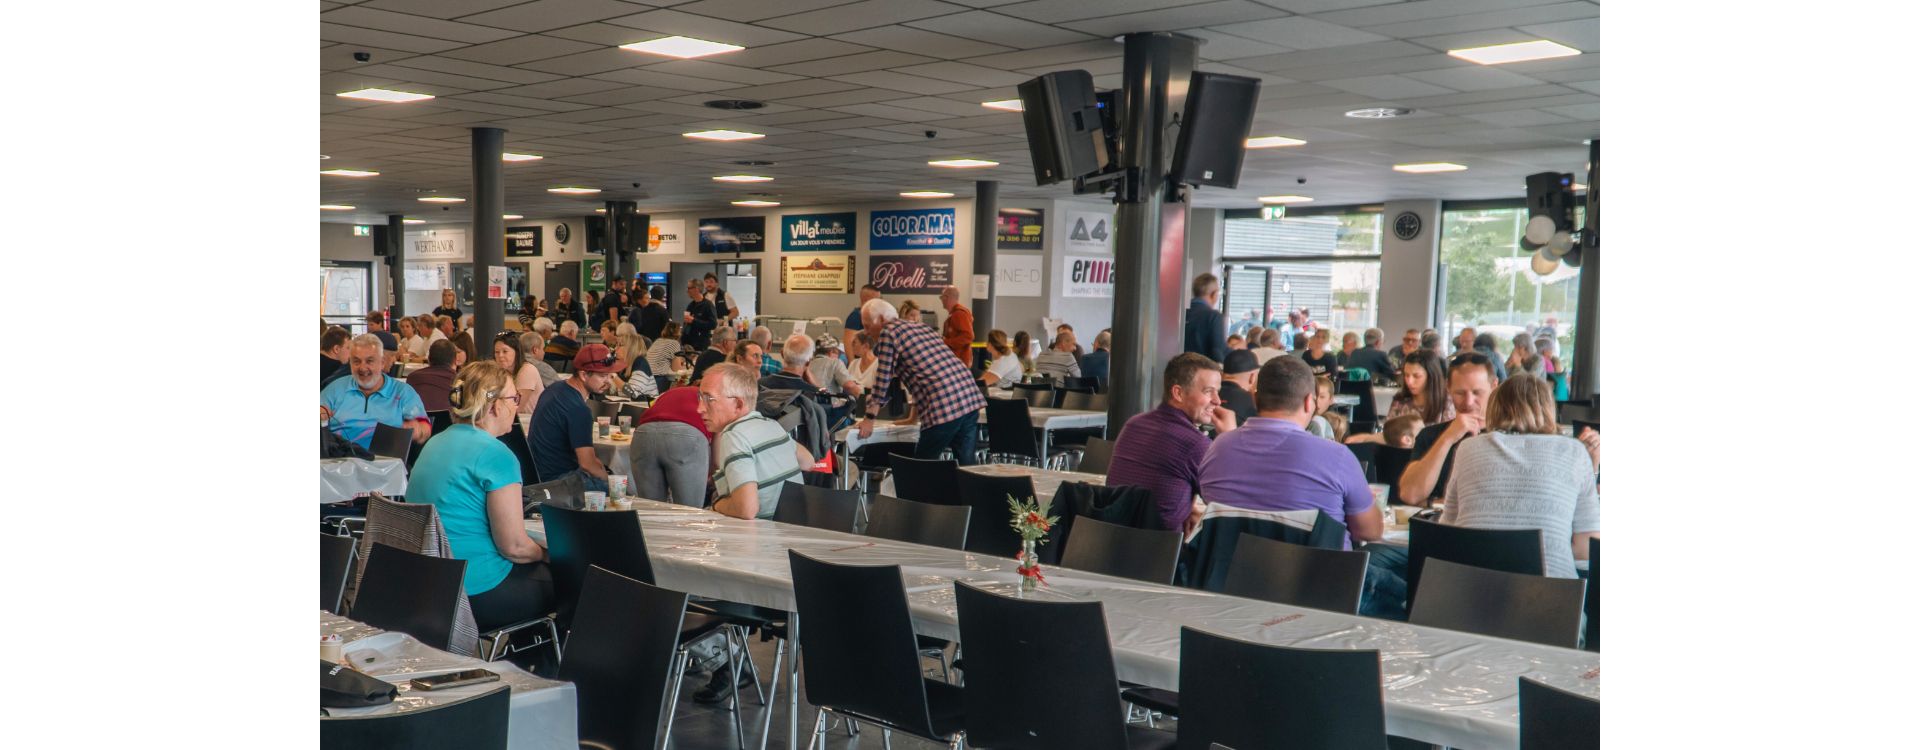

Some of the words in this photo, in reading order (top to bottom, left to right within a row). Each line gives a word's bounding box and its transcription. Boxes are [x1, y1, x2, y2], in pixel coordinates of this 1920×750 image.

[790, 220, 820, 239] Villat
[873, 214, 953, 237] COLORAMA
[414, 240, 455, 253] WERTHANOR
[872, 261, 926, 289] Roelli
